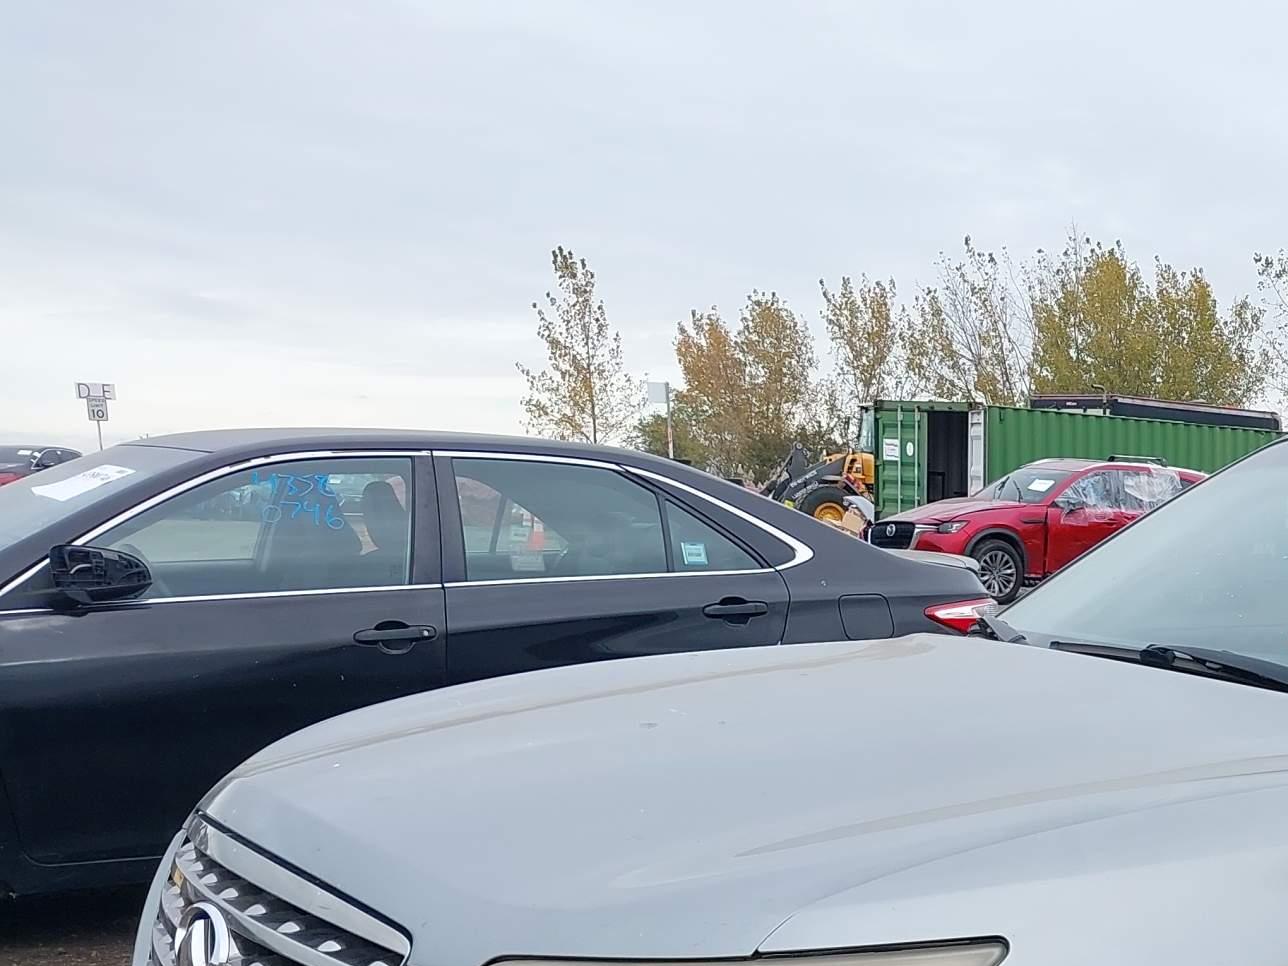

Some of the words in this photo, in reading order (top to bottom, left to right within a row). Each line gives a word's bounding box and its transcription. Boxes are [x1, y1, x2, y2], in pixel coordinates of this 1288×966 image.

[77, 382, 90, 399] D
[101, 383, 113, 400] E
[91, 409, 105, 419] 10
[262, 501, 345, 530] 0746
